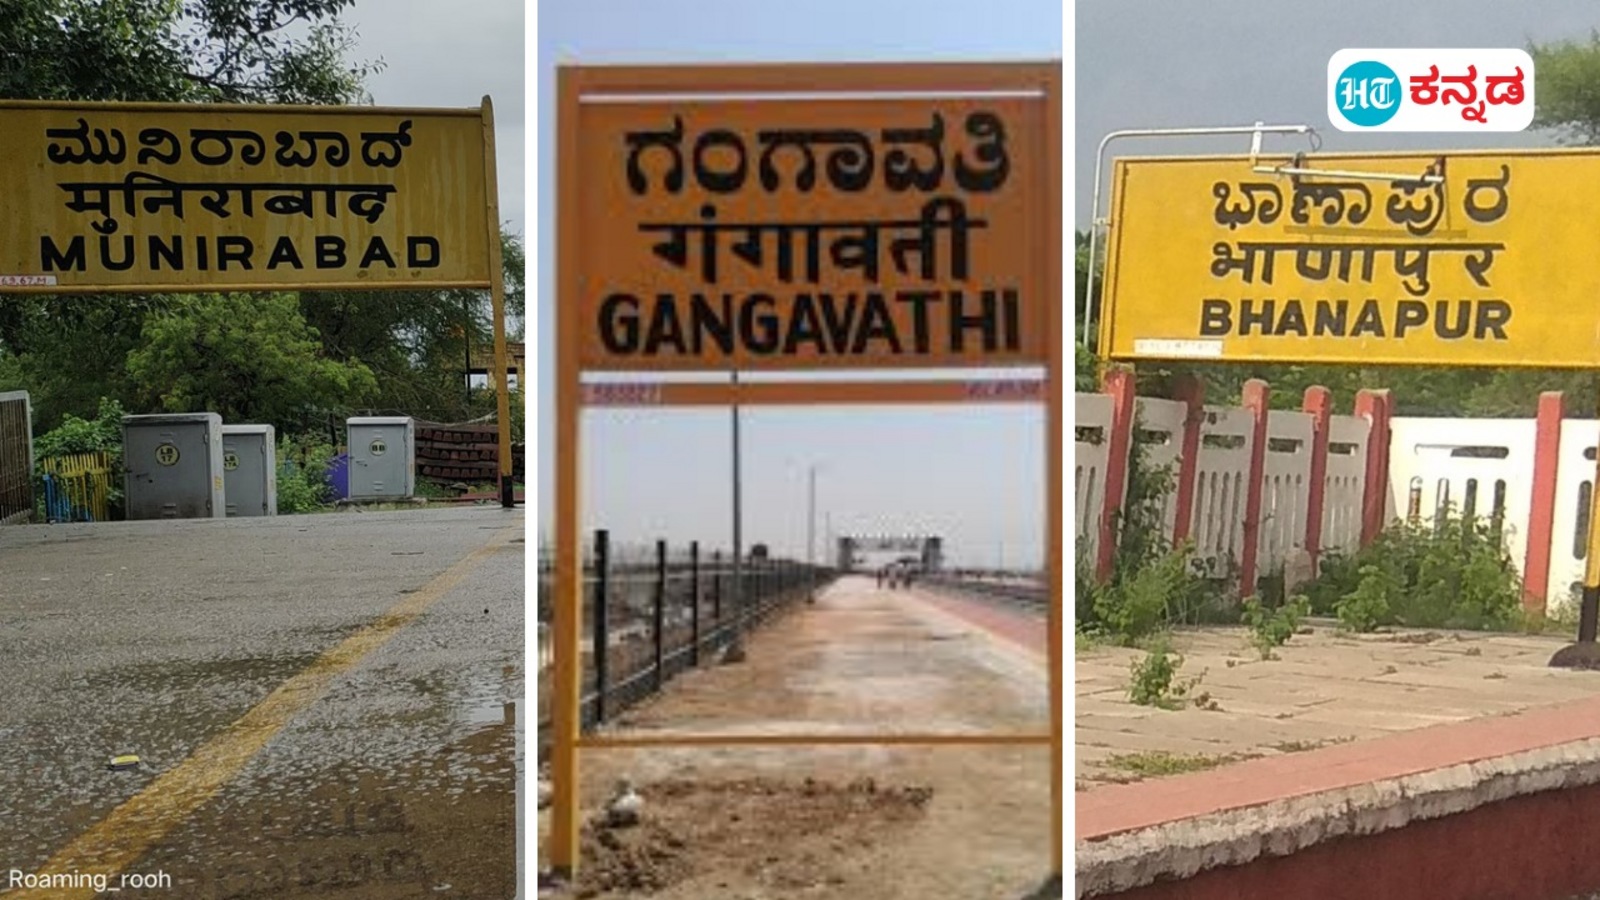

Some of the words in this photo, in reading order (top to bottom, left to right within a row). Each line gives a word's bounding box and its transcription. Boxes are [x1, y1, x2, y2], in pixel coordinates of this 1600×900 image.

[46, 118, 413, 168] ಮುನಿರಾಬಾದ್
[625, 112, 1010, 195] ಗಂಗಾವತಿ
[57, 172, 398, 234] मुनिराबाद
[40, 235, 440, 272] MUNIRABAD
[638, 196, 988, 284] गंगावती
[1211, 241, 1506, 296] भाणापुर
[598, 289, 1021, 355] GANGAVATHI
[1200, 299, 1512, 340] BHANAPUR
